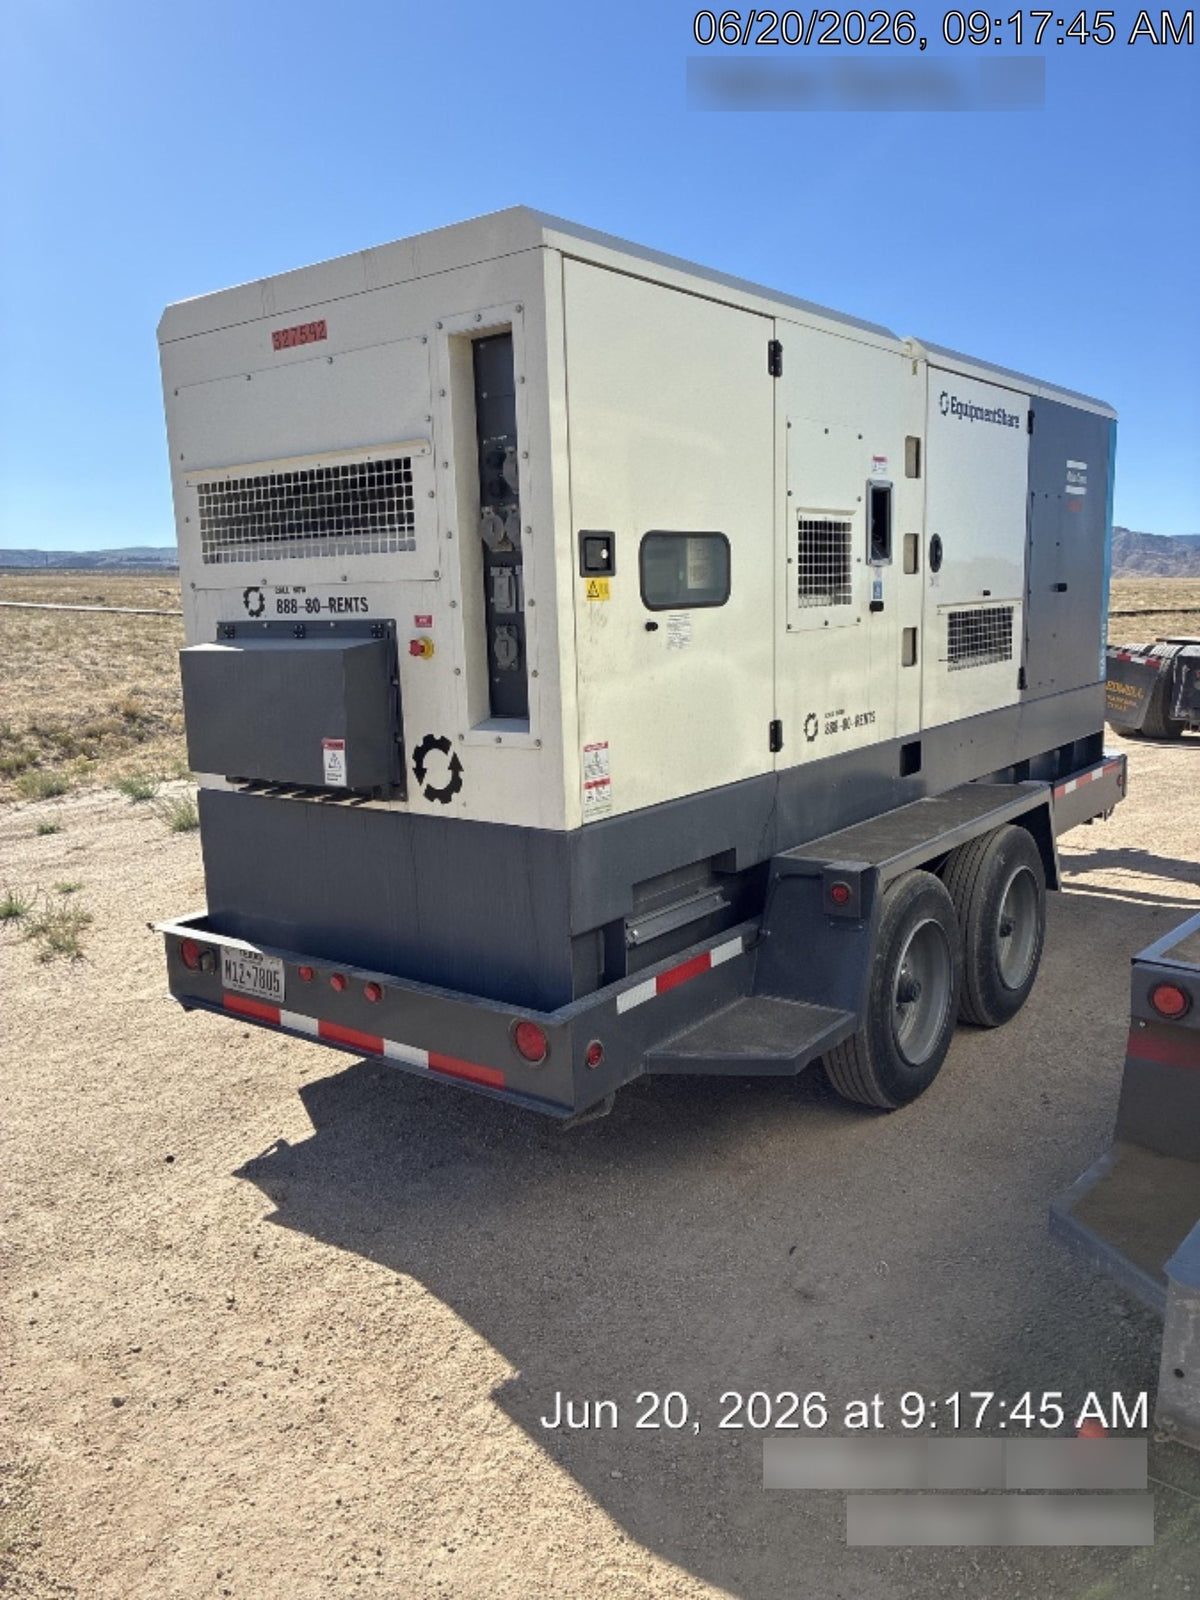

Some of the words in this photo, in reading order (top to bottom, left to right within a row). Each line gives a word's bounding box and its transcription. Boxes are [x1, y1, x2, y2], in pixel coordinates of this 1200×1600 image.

[272, 320, 327, 351] 327592
[950, 396, 1020, 429] EquipmentShare
[276, 597, 369, 614] 888-80-RENTS
